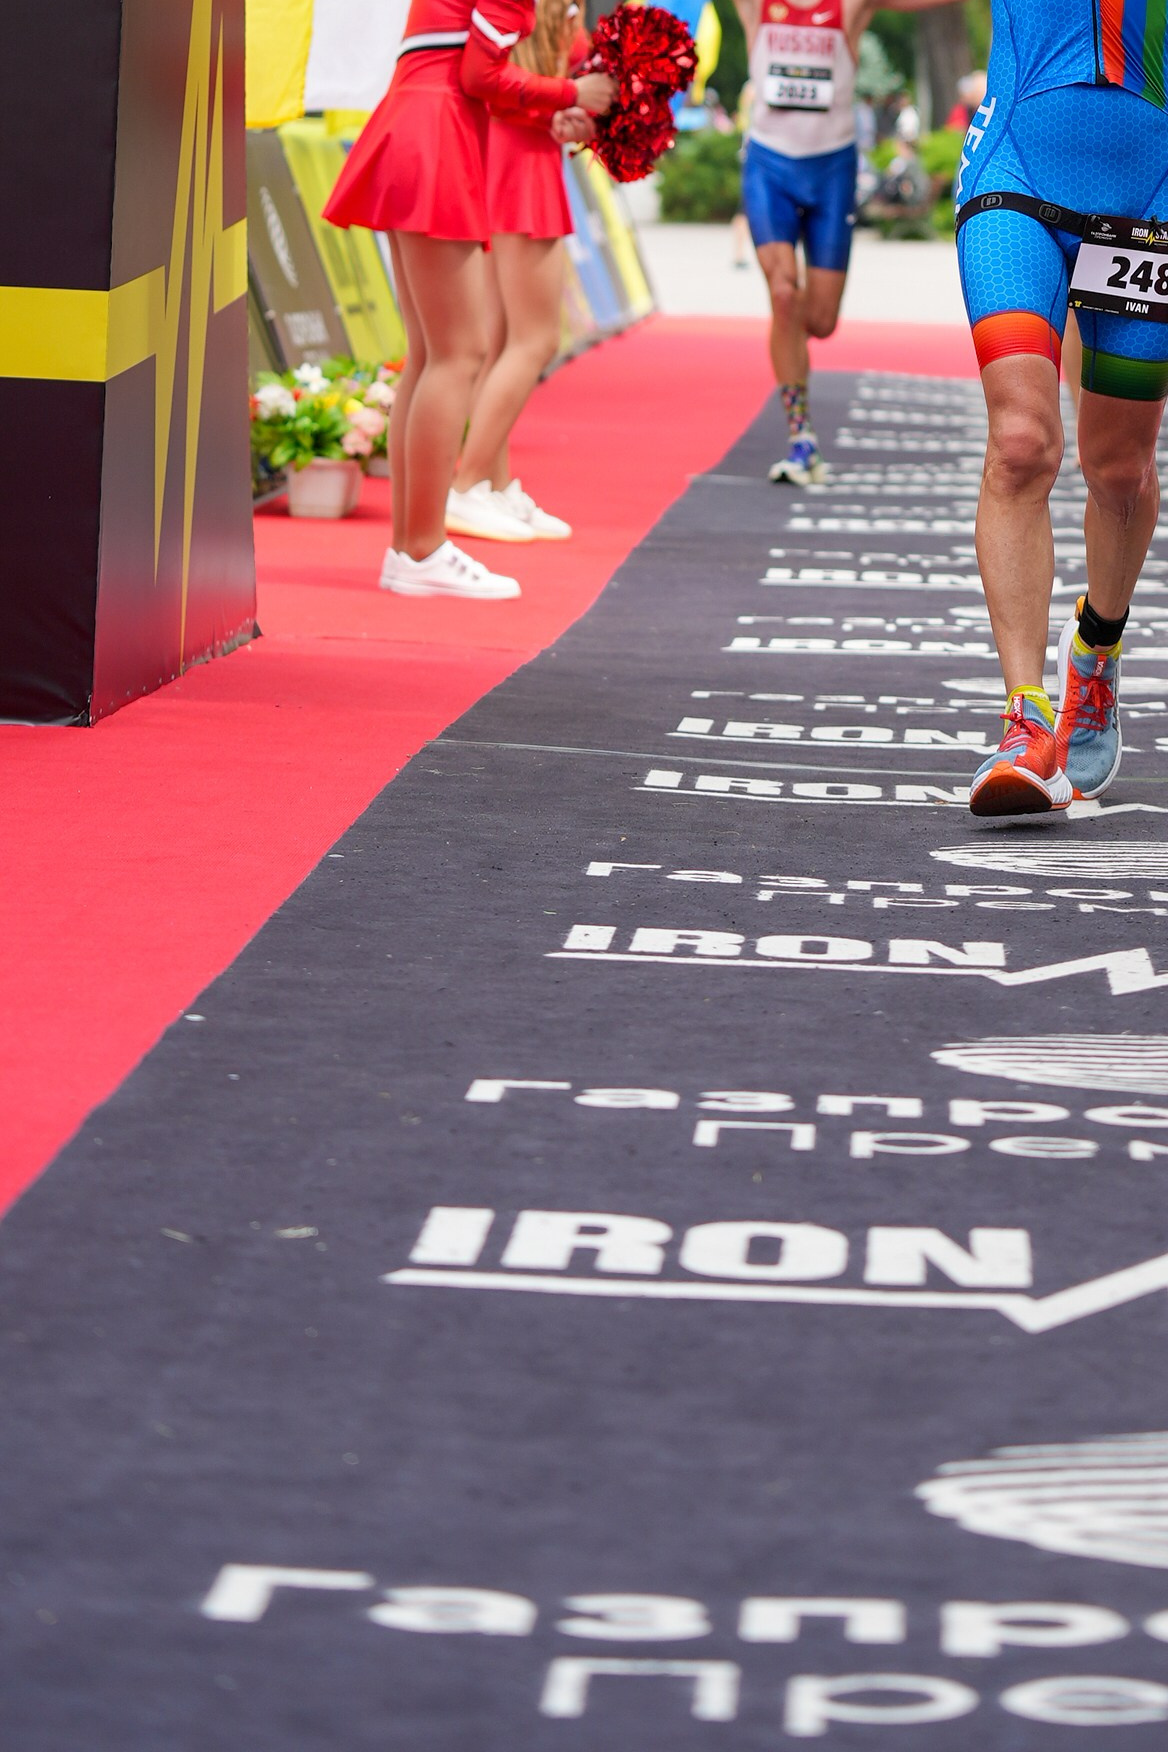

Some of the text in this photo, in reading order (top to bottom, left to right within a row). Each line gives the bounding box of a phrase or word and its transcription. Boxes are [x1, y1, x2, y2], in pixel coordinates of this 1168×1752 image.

[1131, 227, 1149, 238] IRON
[1125, 301, 1150, 314] IVAN
[676, 717, 987, 745] IRON
[562, 925, 1006, 967] IRON
[408, 1205, 1032, 1288] IRON
